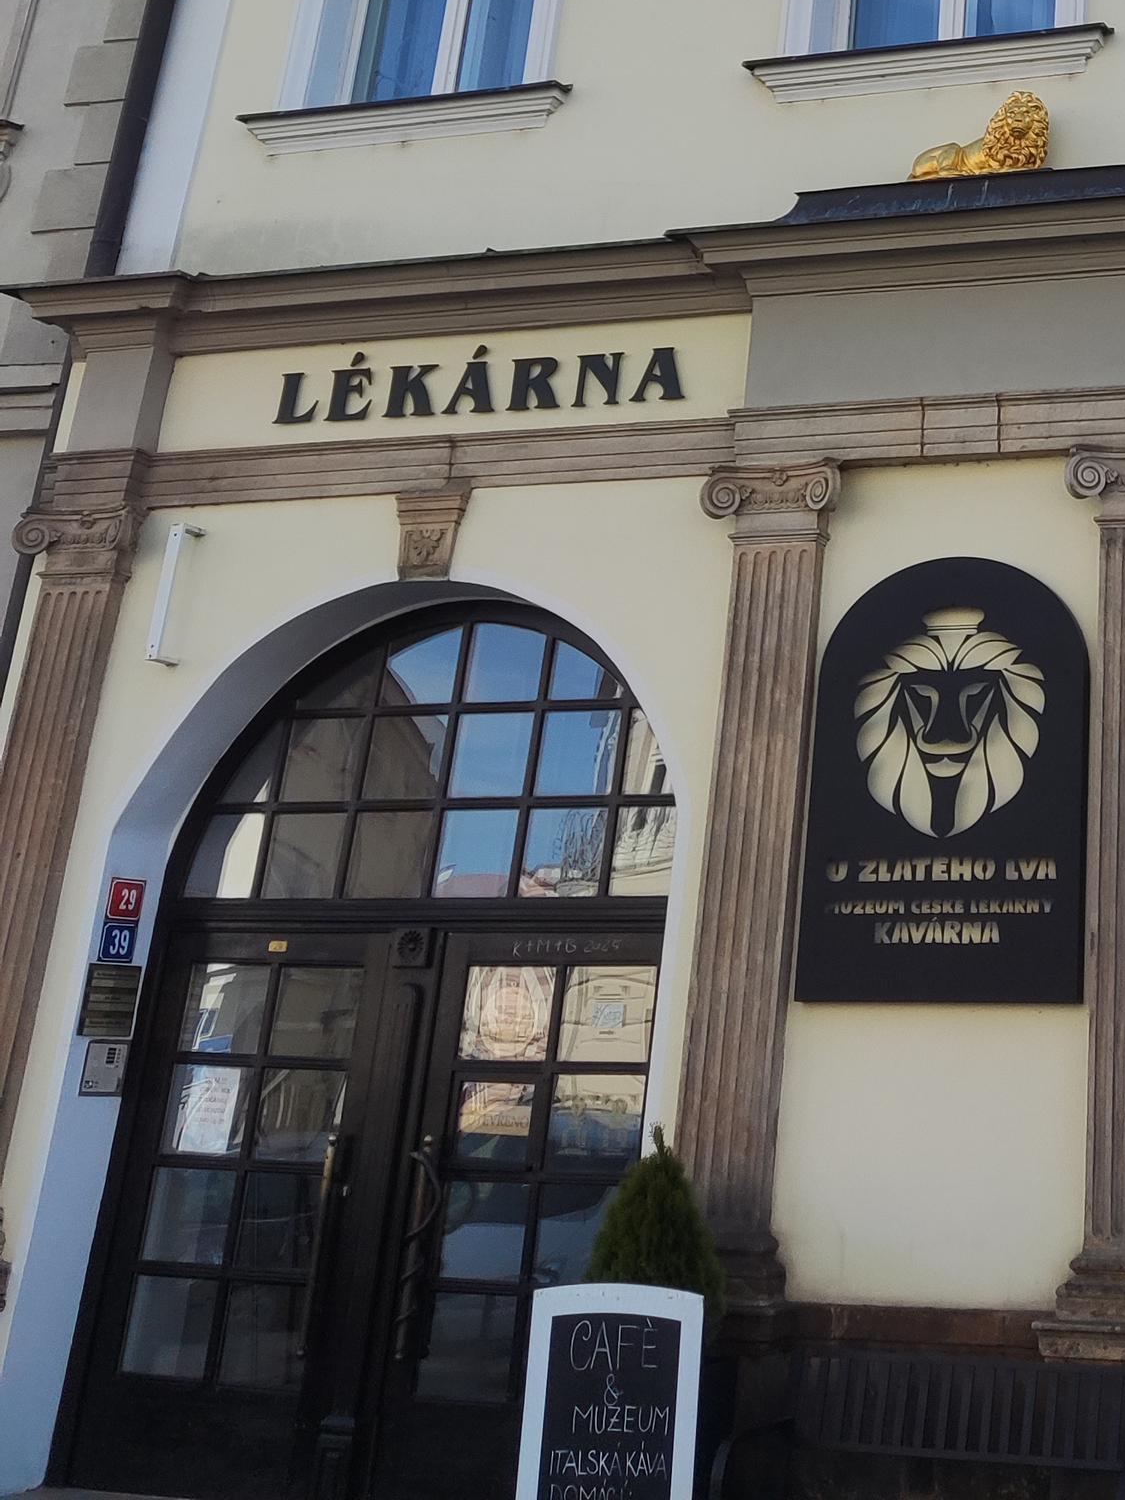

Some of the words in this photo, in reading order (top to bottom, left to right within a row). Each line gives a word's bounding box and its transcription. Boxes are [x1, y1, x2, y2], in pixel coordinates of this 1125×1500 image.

[273, 345, 686, 425] LÉKÁRNA
[826, 858, 849, 882] U
[1005, 857, 1057, 880] LVA
[119, 888, 137, 910] 29
[110, 929, 130, 955] 39
[874, 916, 1000, 944] KAVÁRNA
[603, 1373, 623, 1406] &
[572, 1403, 670, 1437] MUZEUM
[550, 1442, 622, 1477] ITALSKÁ
[625, 1441, 668, 1481] KÁVA
